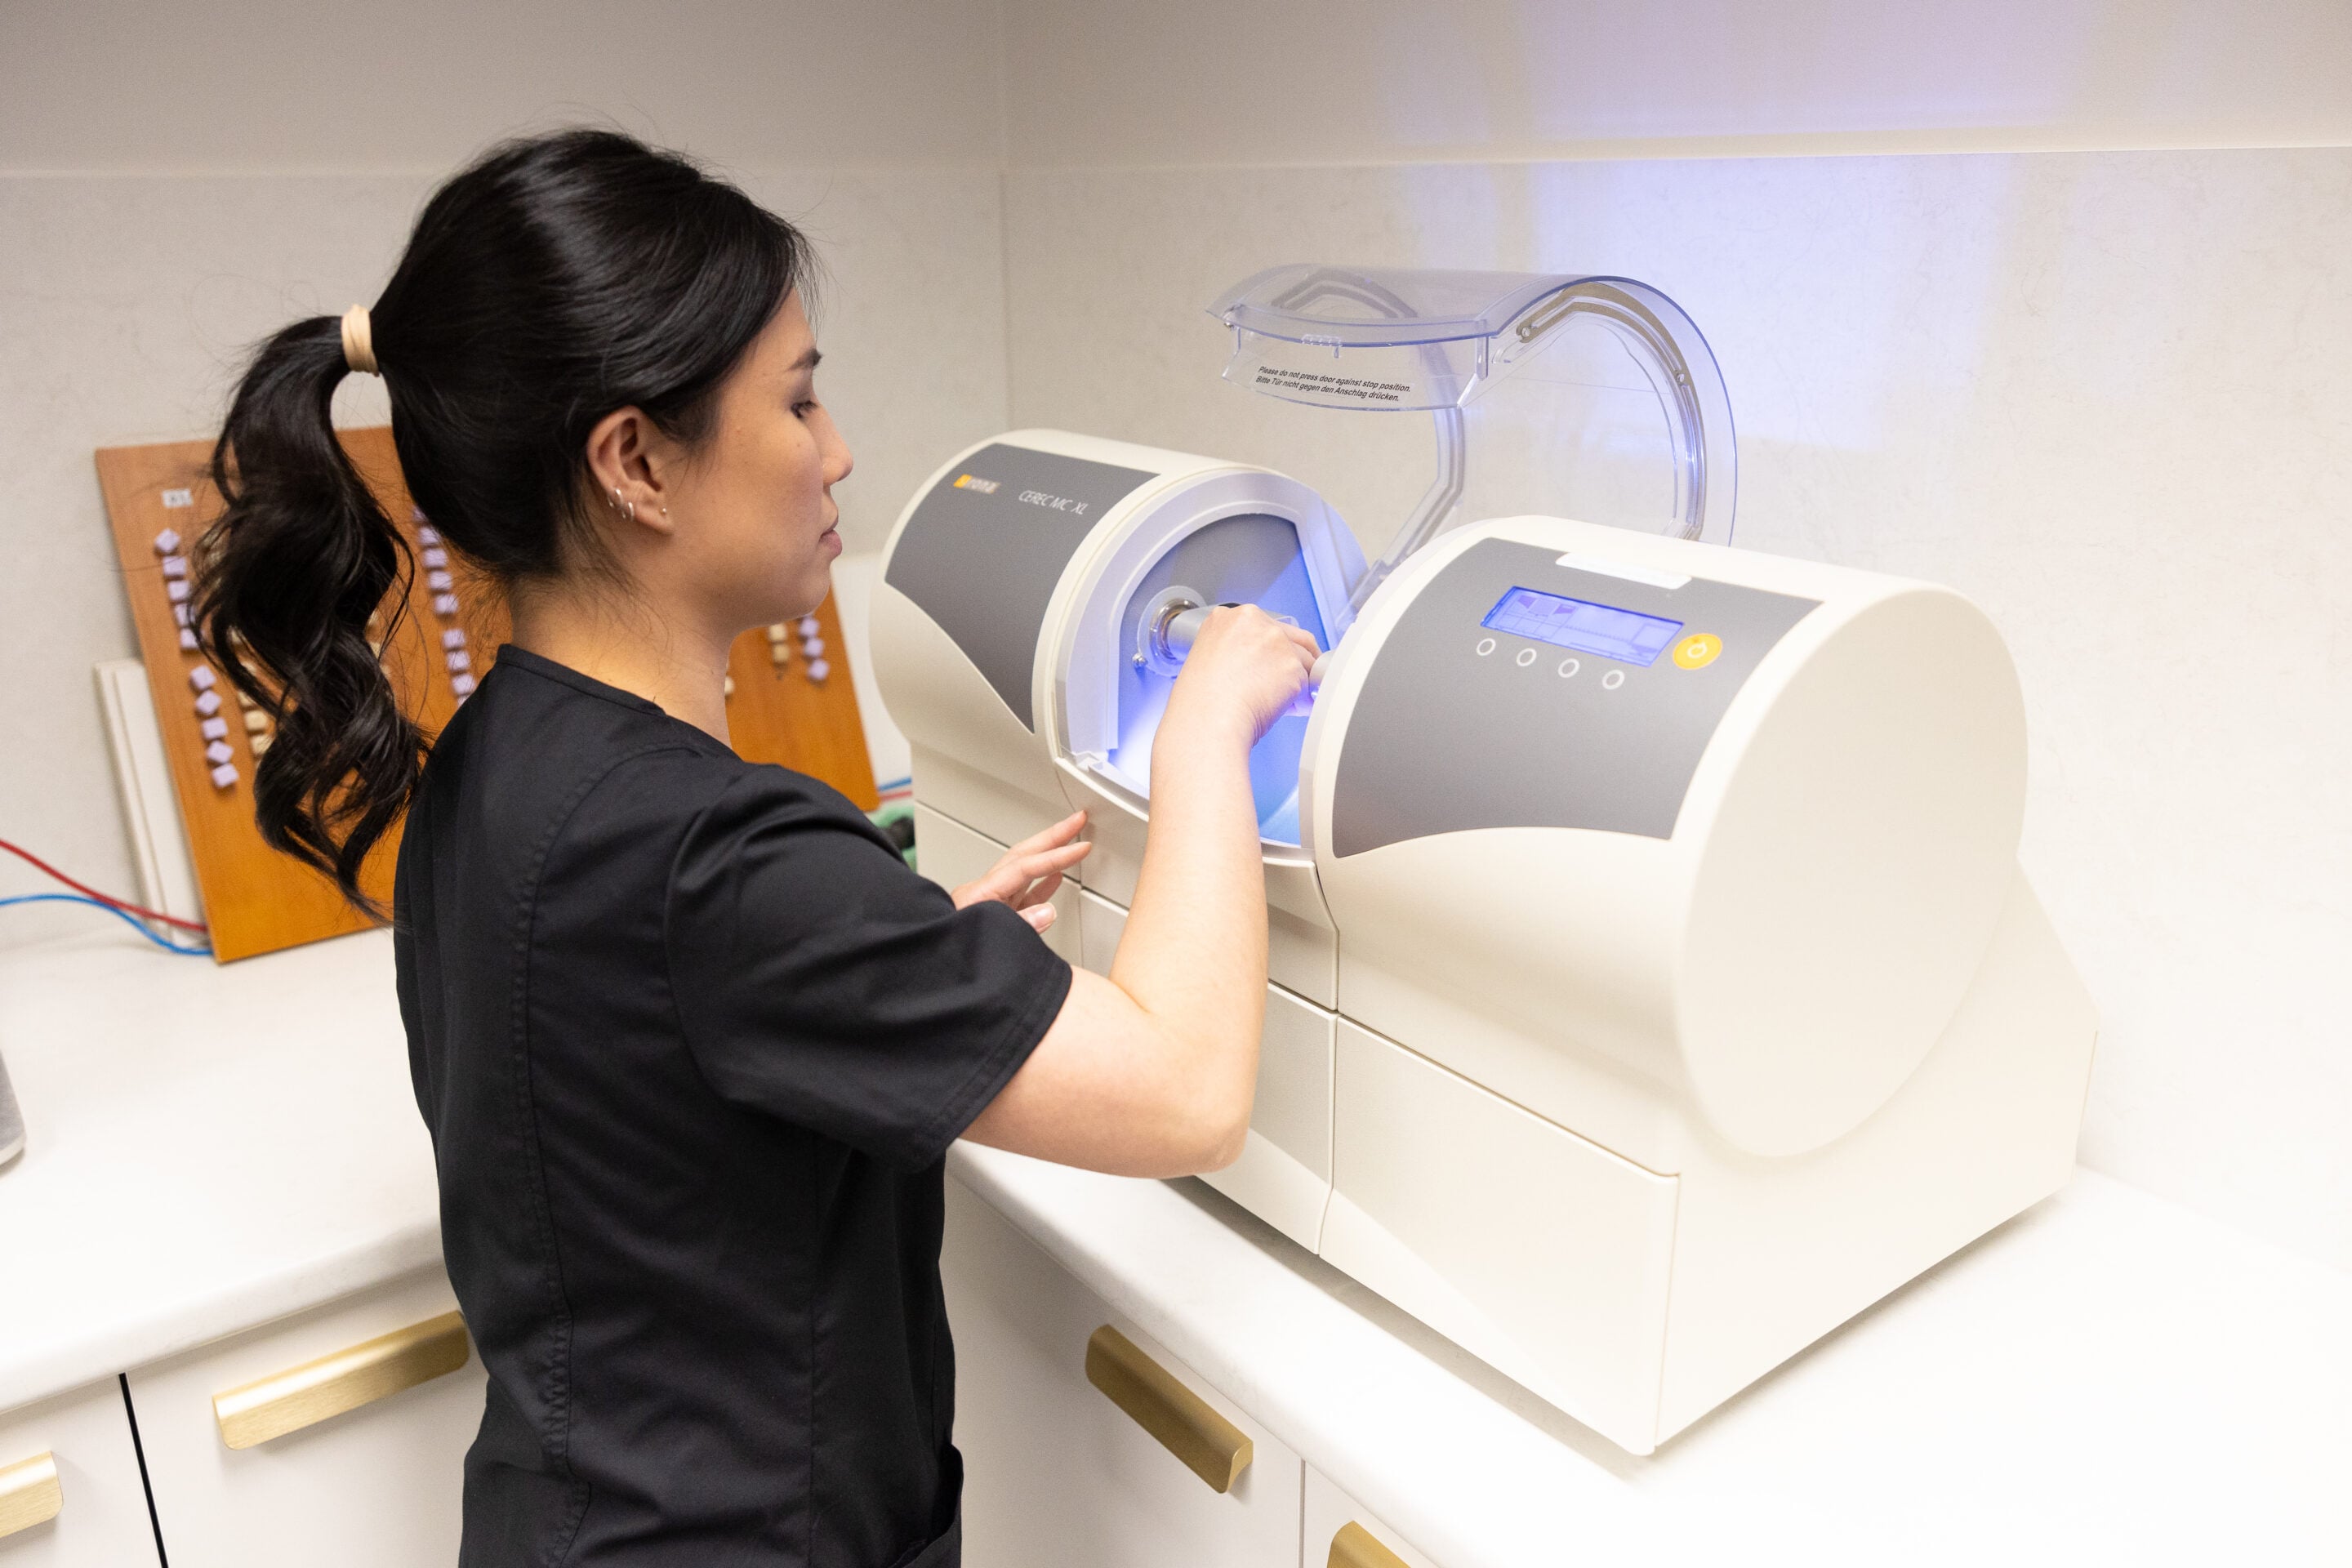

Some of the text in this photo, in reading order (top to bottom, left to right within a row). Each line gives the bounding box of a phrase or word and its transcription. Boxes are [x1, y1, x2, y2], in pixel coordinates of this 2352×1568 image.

[1255, 376, 1271, 384] Bitte
[1272, 377, 1283, 385] Tür
[1282, 380, 1300, 388] nicht
[1298, 383, 1321, 392] gegen
[1334, 387, 1368, 399] Anschlag
[1369, 391, 1399, 401] drücken.
[1258, 366, 1279, 376] Please
[1299, 373, 1318, 381] press
[1319, 375, 1336, 383] door
[1336, 378, 1362, 386] against
[1362, 381, 1379, 389] stop
[1379, 383, 1410, 392] position.
[1018, 490, 1089, 514] CEREC MC XL
